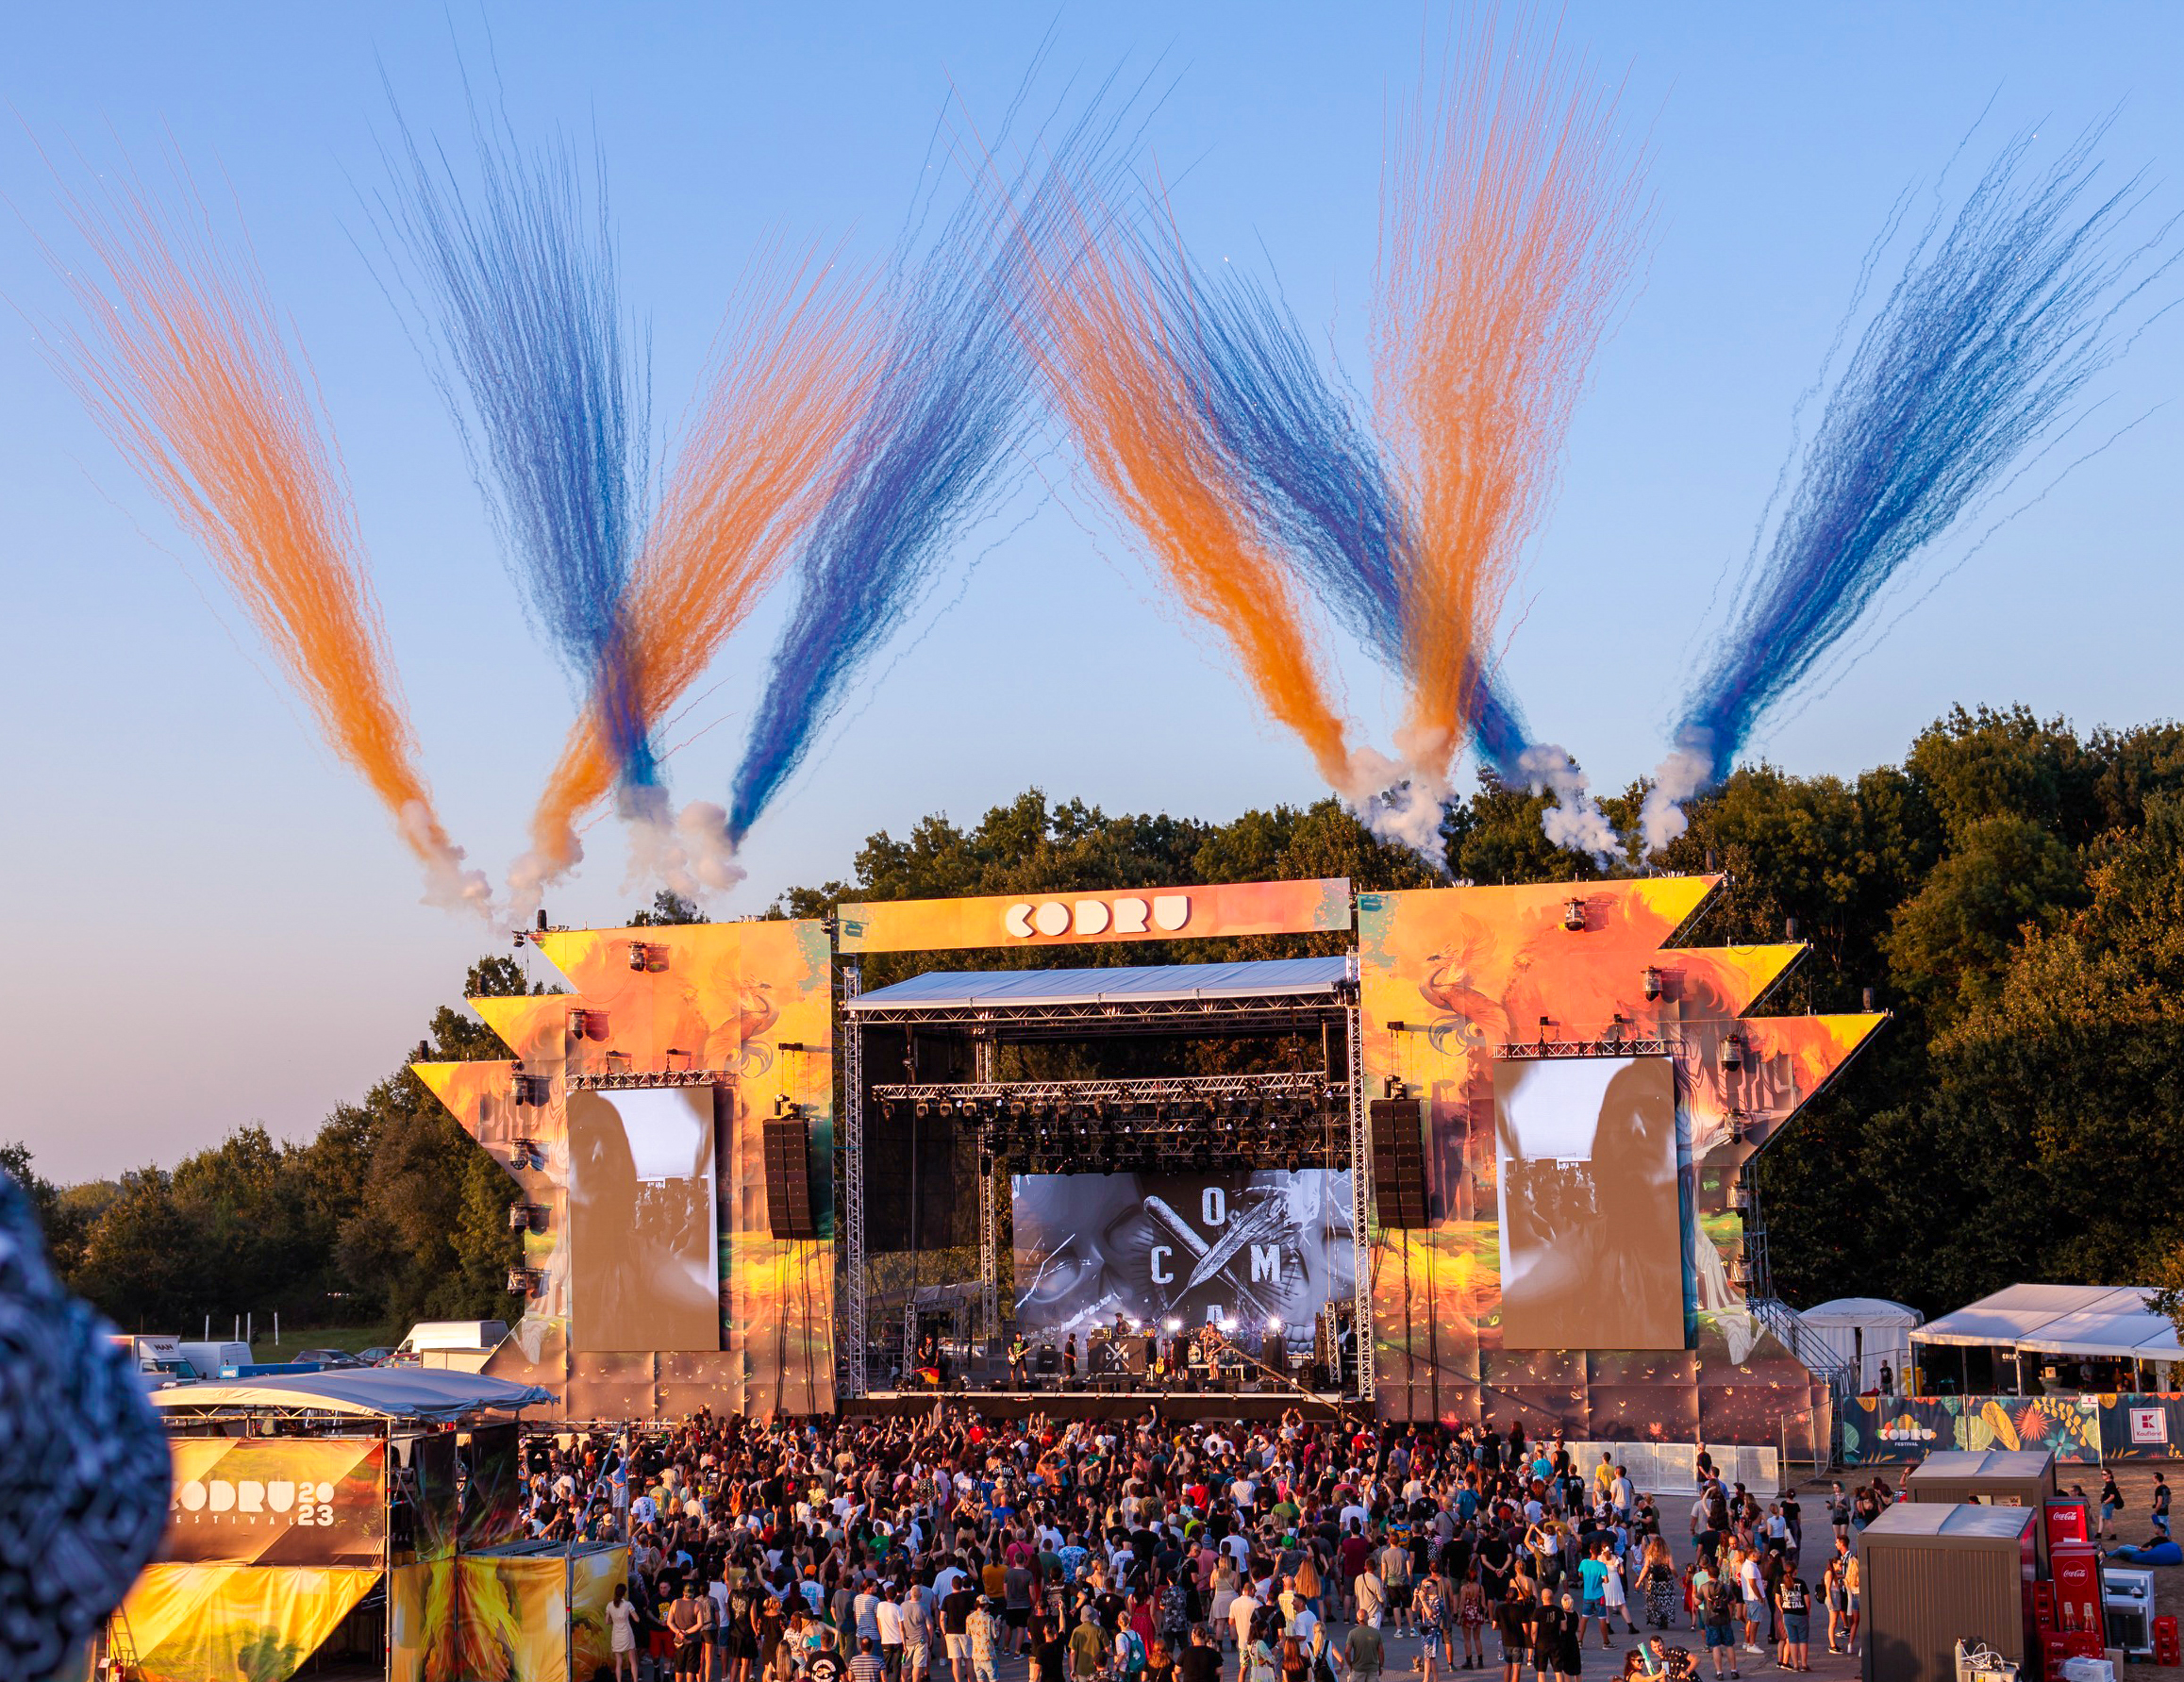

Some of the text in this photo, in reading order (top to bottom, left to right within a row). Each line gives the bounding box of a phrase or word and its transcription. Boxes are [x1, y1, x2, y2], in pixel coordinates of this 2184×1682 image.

[1006, 895, 1192, 938] CODRU
[1202, 1187, 1225, 1226] O
[1151, 1244, 1281, 1284] C M
[298, 1482, 335, 1503] 20
[175, 1515, 294, 1526] ESTIVAL
[298, 1505, 334, 1526] 23
[2053, 1511, 2077, 1521] Coca-Cola
[2063, 1569, 2086, 1578] Coca-Cola
